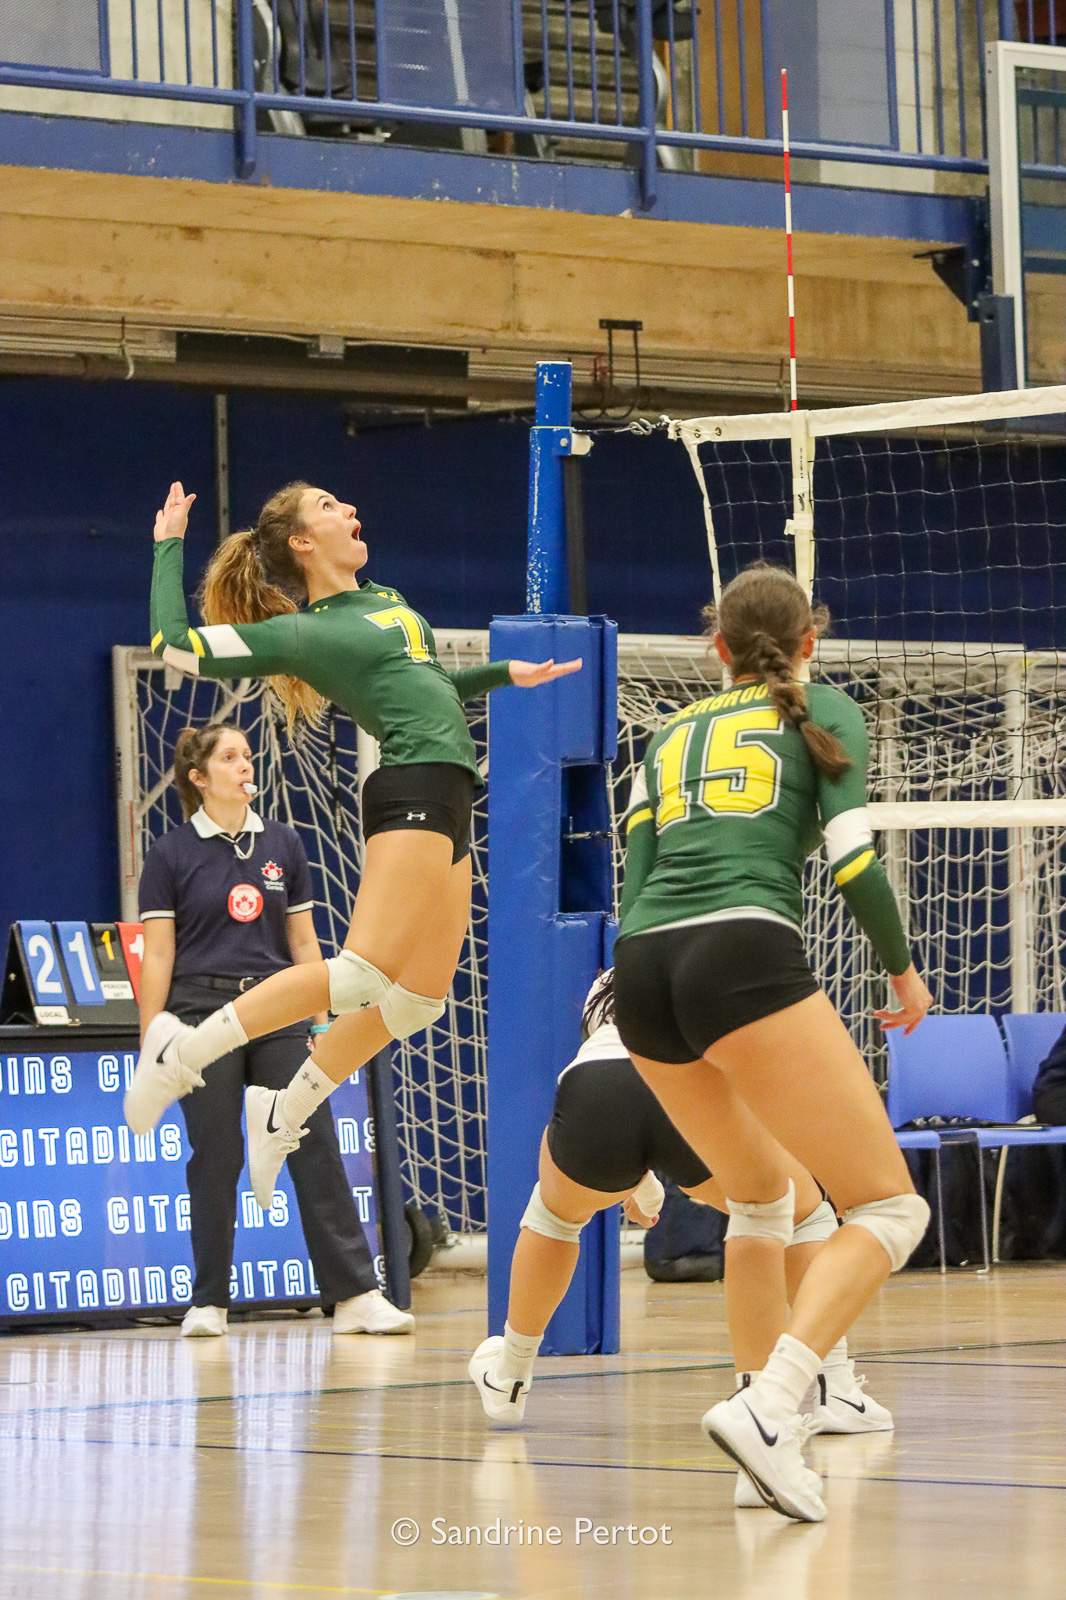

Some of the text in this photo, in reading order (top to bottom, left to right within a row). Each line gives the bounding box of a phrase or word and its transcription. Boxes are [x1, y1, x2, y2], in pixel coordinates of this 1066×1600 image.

[363, 605, 434, 663] 7
[653, 705, 785, 836] 15
[101, 930, 115, 961] 1
[0, 1056, 73, 1095] INS
[0, 1123, 182, 1168] CITADINS
[6, 1264, 193, 1312] CITADINS
